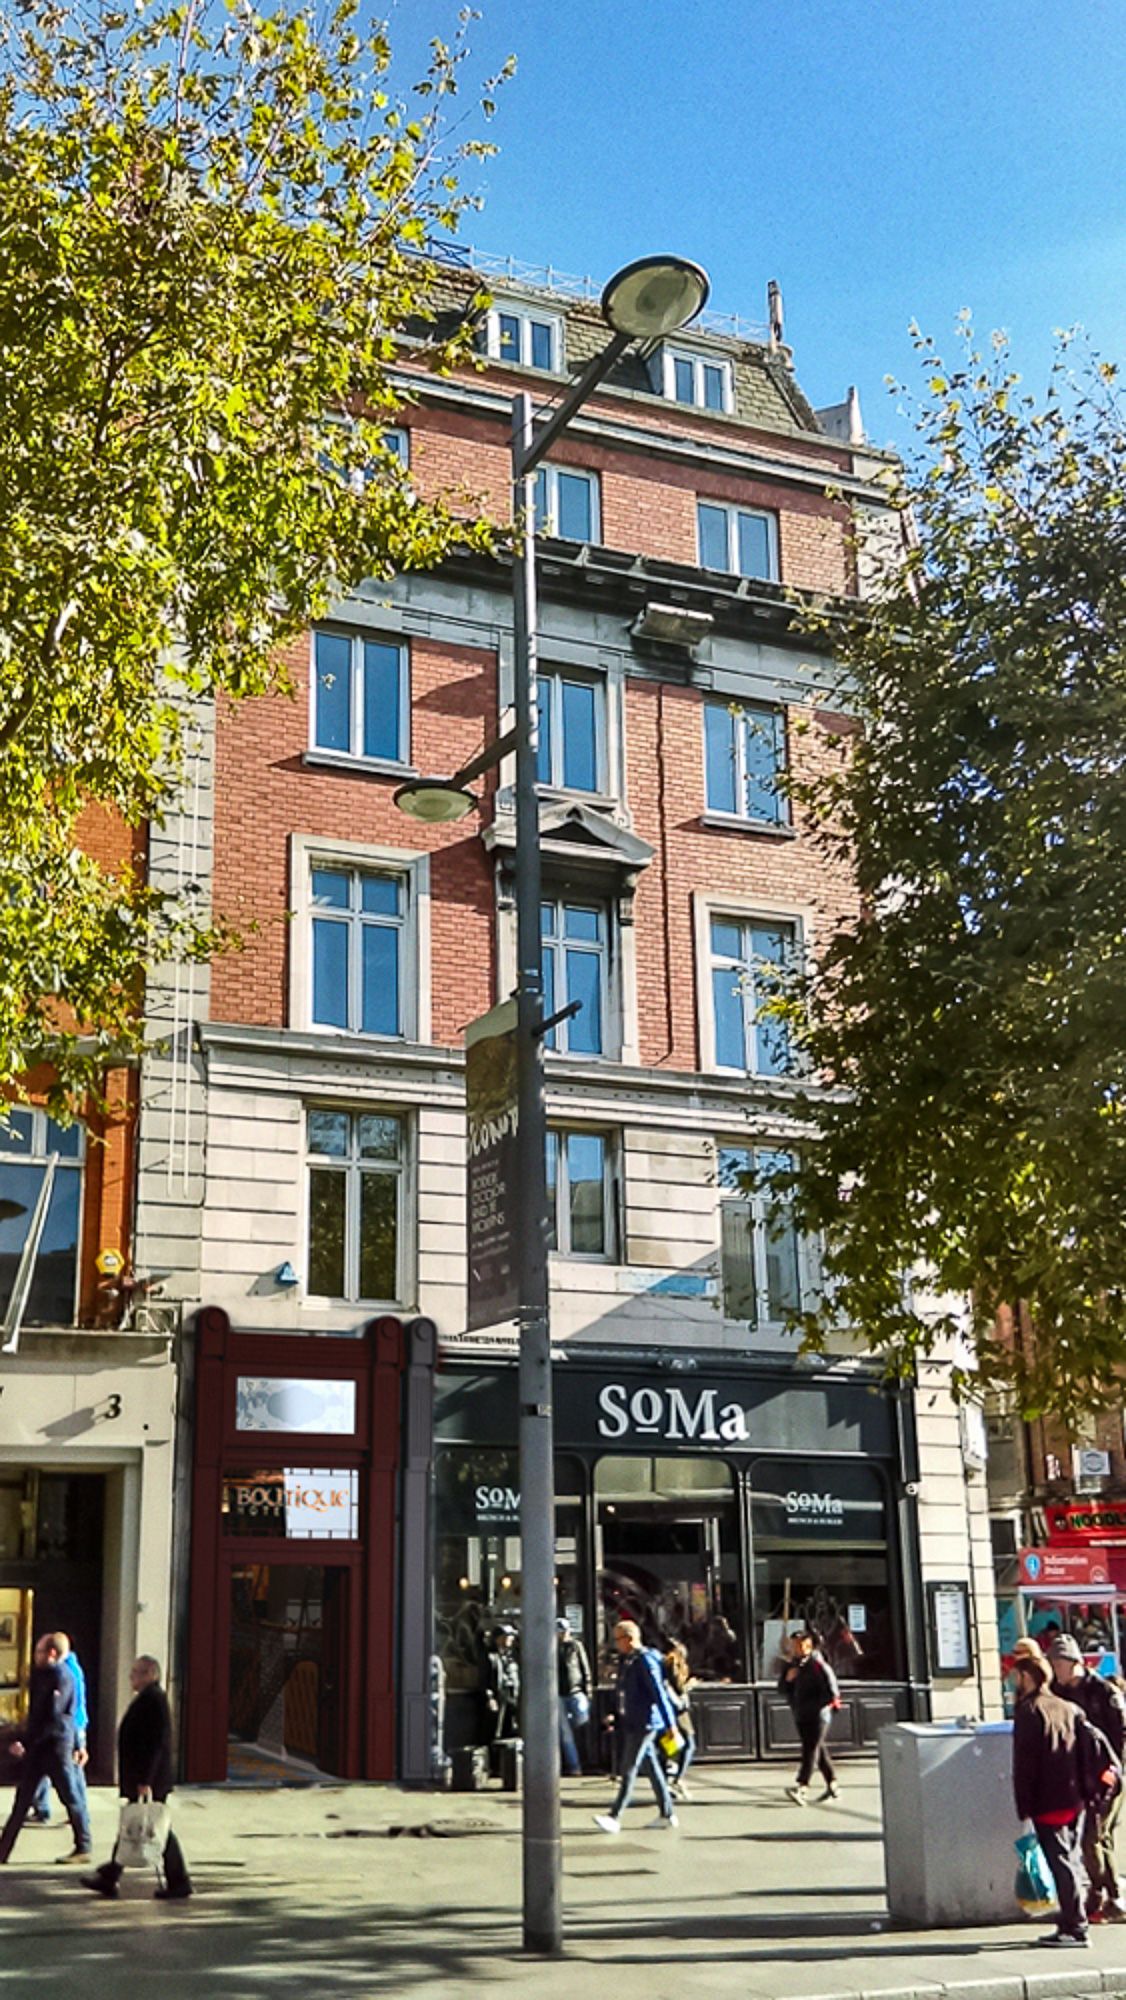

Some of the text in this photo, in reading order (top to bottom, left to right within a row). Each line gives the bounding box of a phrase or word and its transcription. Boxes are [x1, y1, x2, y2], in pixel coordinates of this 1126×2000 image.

[104, 1393, 122, 1419] 3
[475, 1485, 521, 1510] SoM
[1070, 1513, 1126, 1528] NOODL
